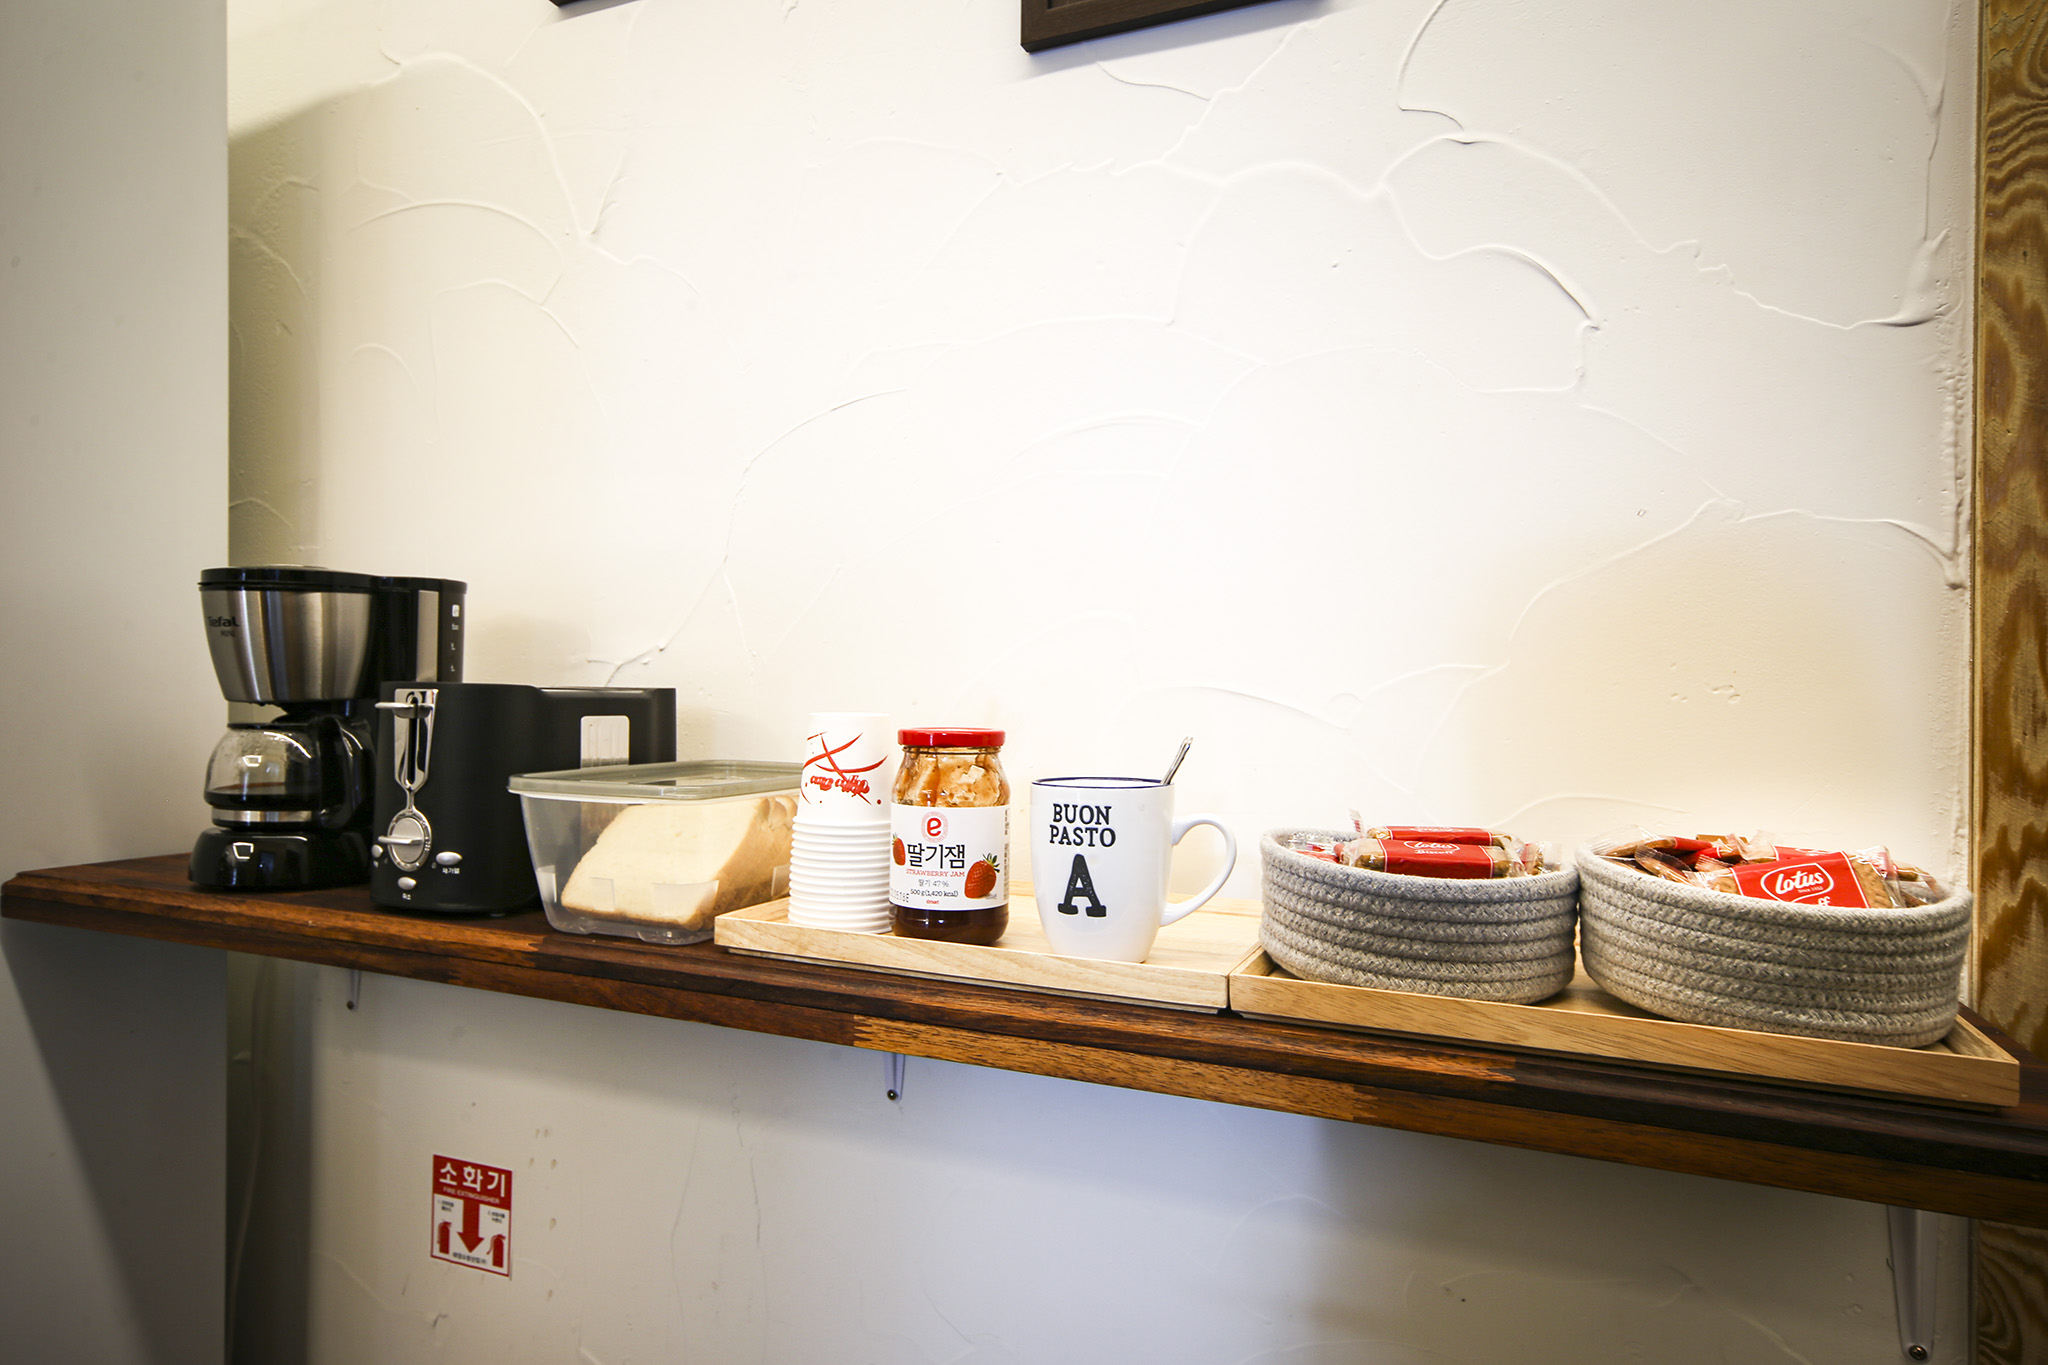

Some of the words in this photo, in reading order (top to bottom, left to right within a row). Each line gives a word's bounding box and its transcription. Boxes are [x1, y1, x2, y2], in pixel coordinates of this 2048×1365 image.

[207, 616, 240, 627] Tefal
[1053, 803, 1112, 825] BUON
[927, 817, 942, 837] e
[1049, 824, 1116, 848] PASTO
[907, 843, 966, 869] 딸기잼
[906, 868, 949, 877] STRAWBERRY
[918, 879, 931, 887] 딸기
[1775, 871, 1824, 895] Lotus
[1057, 853, 1107, 918] A
[439, 1162, 506, 1198] 소화기
